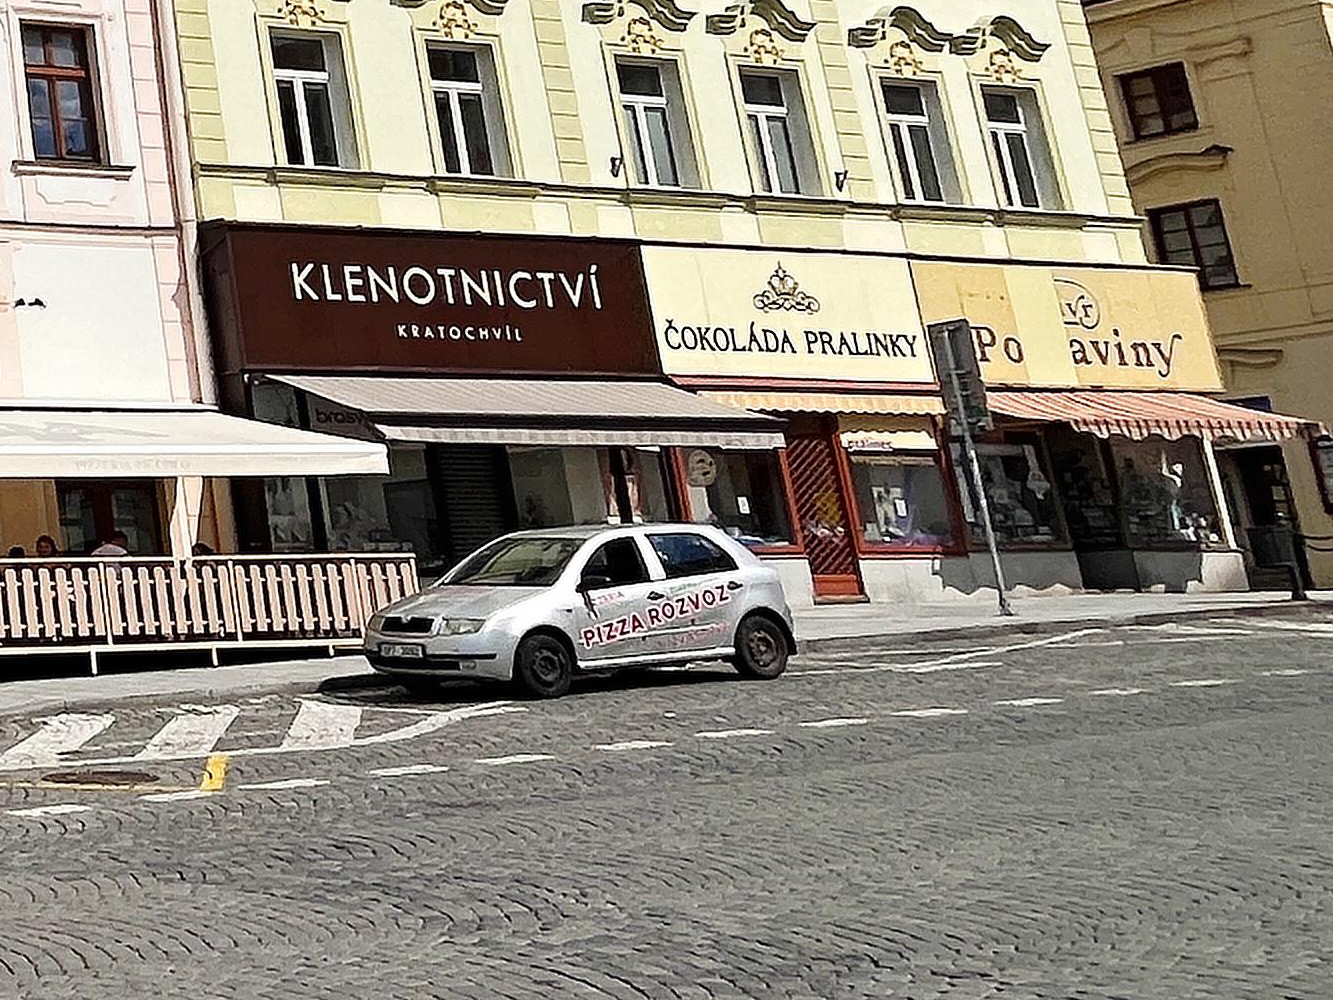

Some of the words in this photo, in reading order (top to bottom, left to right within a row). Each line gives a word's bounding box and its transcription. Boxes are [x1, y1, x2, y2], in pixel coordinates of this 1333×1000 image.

[290, 261, 603, 310] KLENOTNICTVÍ
[396, 323, 524, 342] KRATOCHVÍL
[664, 318, 798, 354] ČOKOLÁDA
[803, 330, 918, 357] PRALINKY
[970, 325, 1183, 377] Poaviny
[583, 613, 645, 647] PIZZA
[647, 584, 730, 626] ROZVOZ
